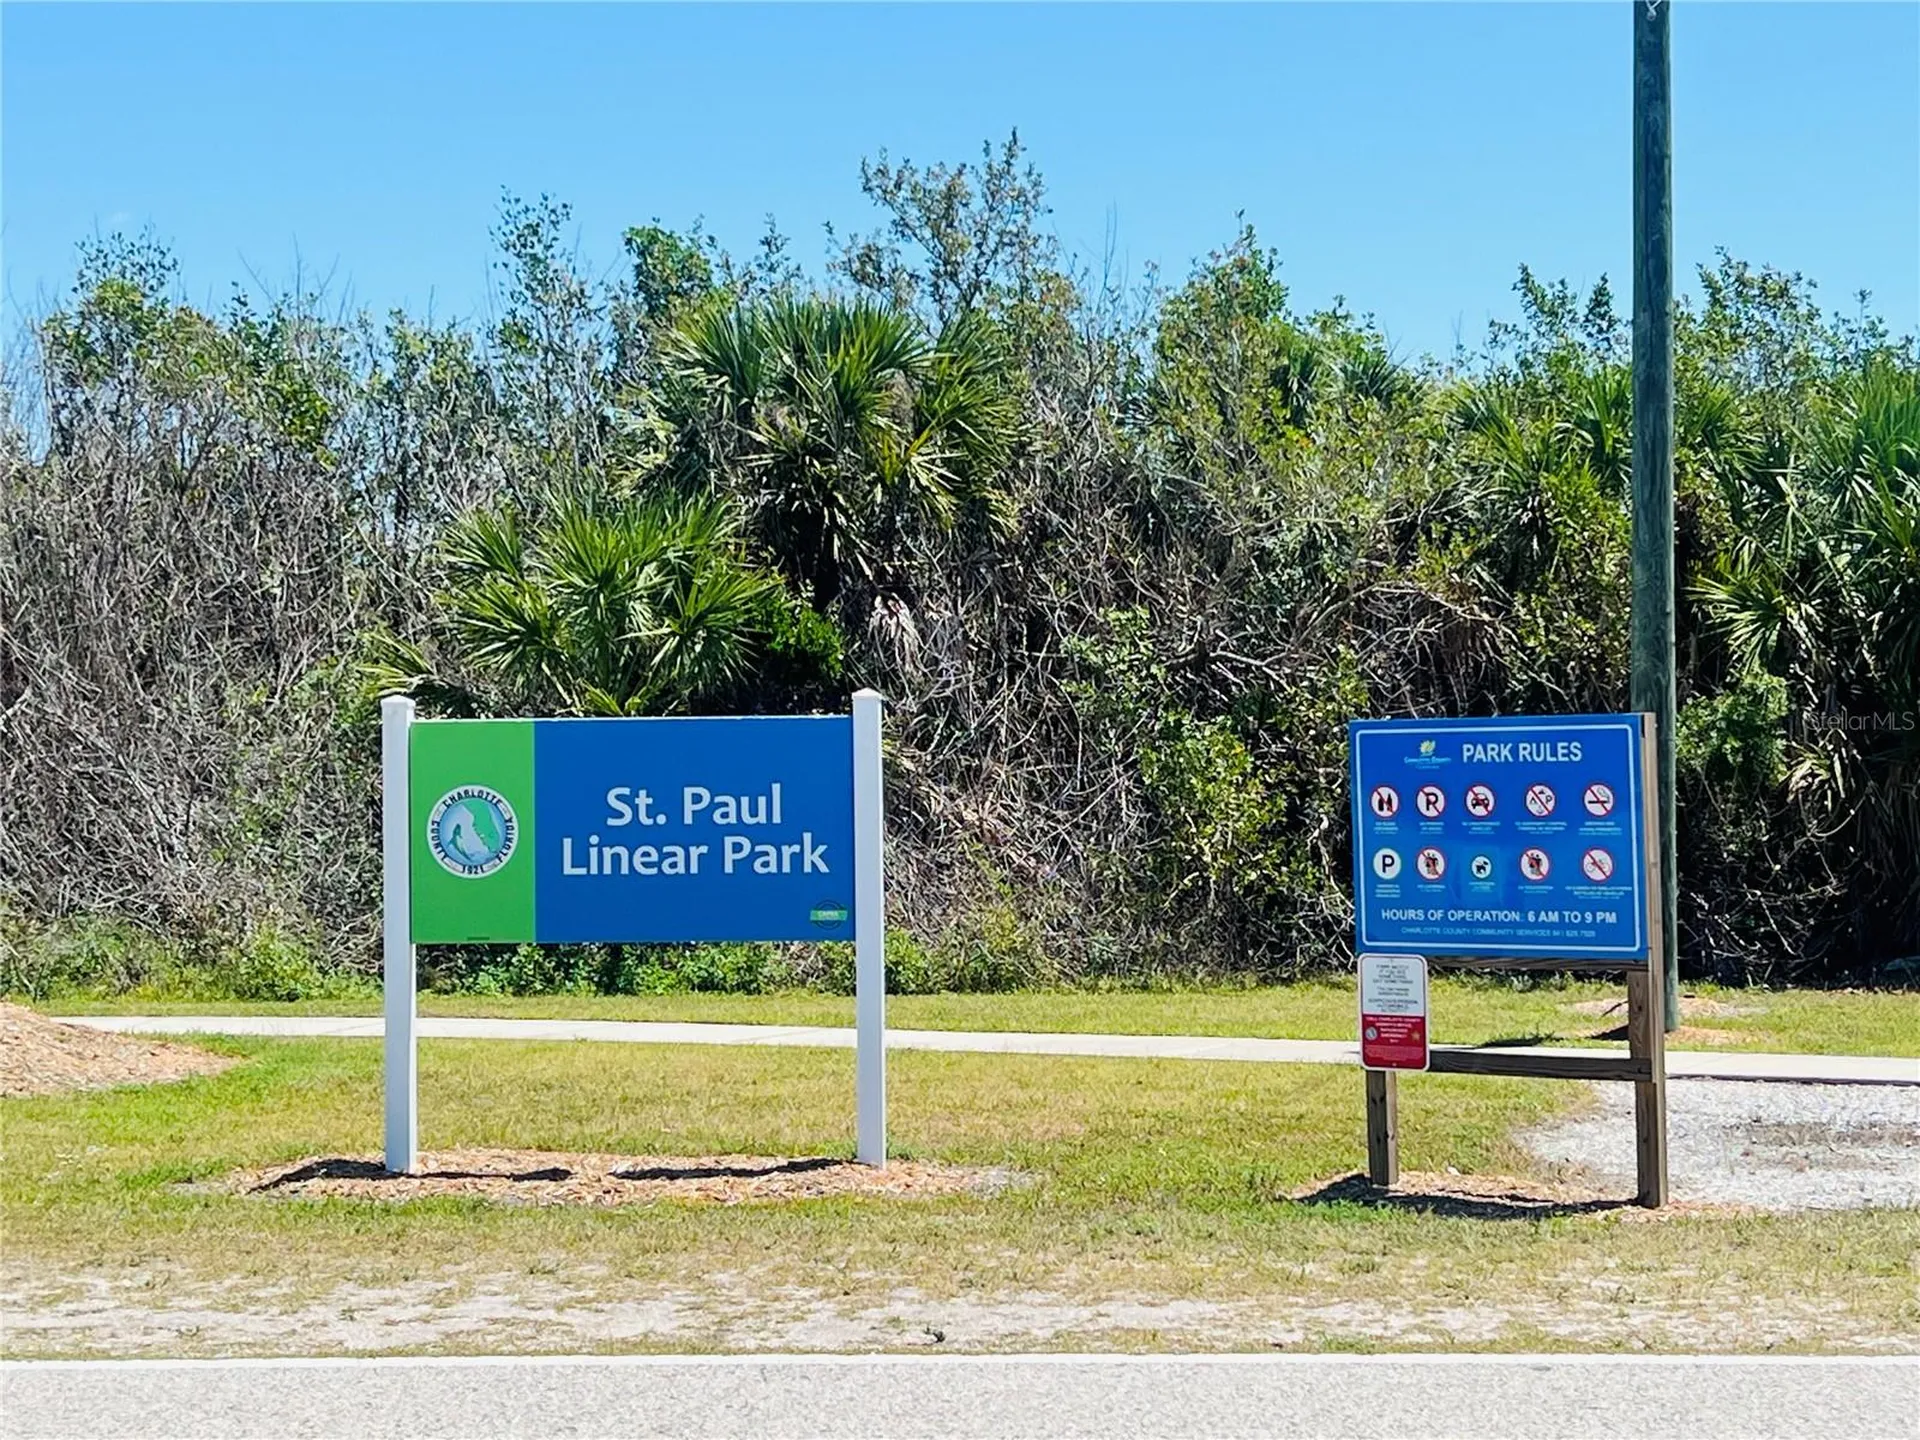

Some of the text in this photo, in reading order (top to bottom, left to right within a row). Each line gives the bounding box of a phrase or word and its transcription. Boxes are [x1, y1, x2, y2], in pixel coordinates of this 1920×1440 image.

[1462, 742, 1582, 763] PARK RULES
[442, 788, 502, 809] CHARLOTTE
[606, 782, 782, 826] St. Paul
[430, 820, 448, 862] COUNTY
[497, 816, 515, 863] FLORIDA
[562, 832, 830, 876] Linear Park
[462, 864, 485, 875] 1921
[1381, 909, 1424, 921] HOURS
[1427, 910, 1444, 921] OF
[1527, 911, 1536, 923] 6
[1538, 911, 1559, 923] AM
[1562, 911, 1581, 923] TO
[1584, 912, 1593, 924] 9
[1596, 912, 1617, 924] PM
